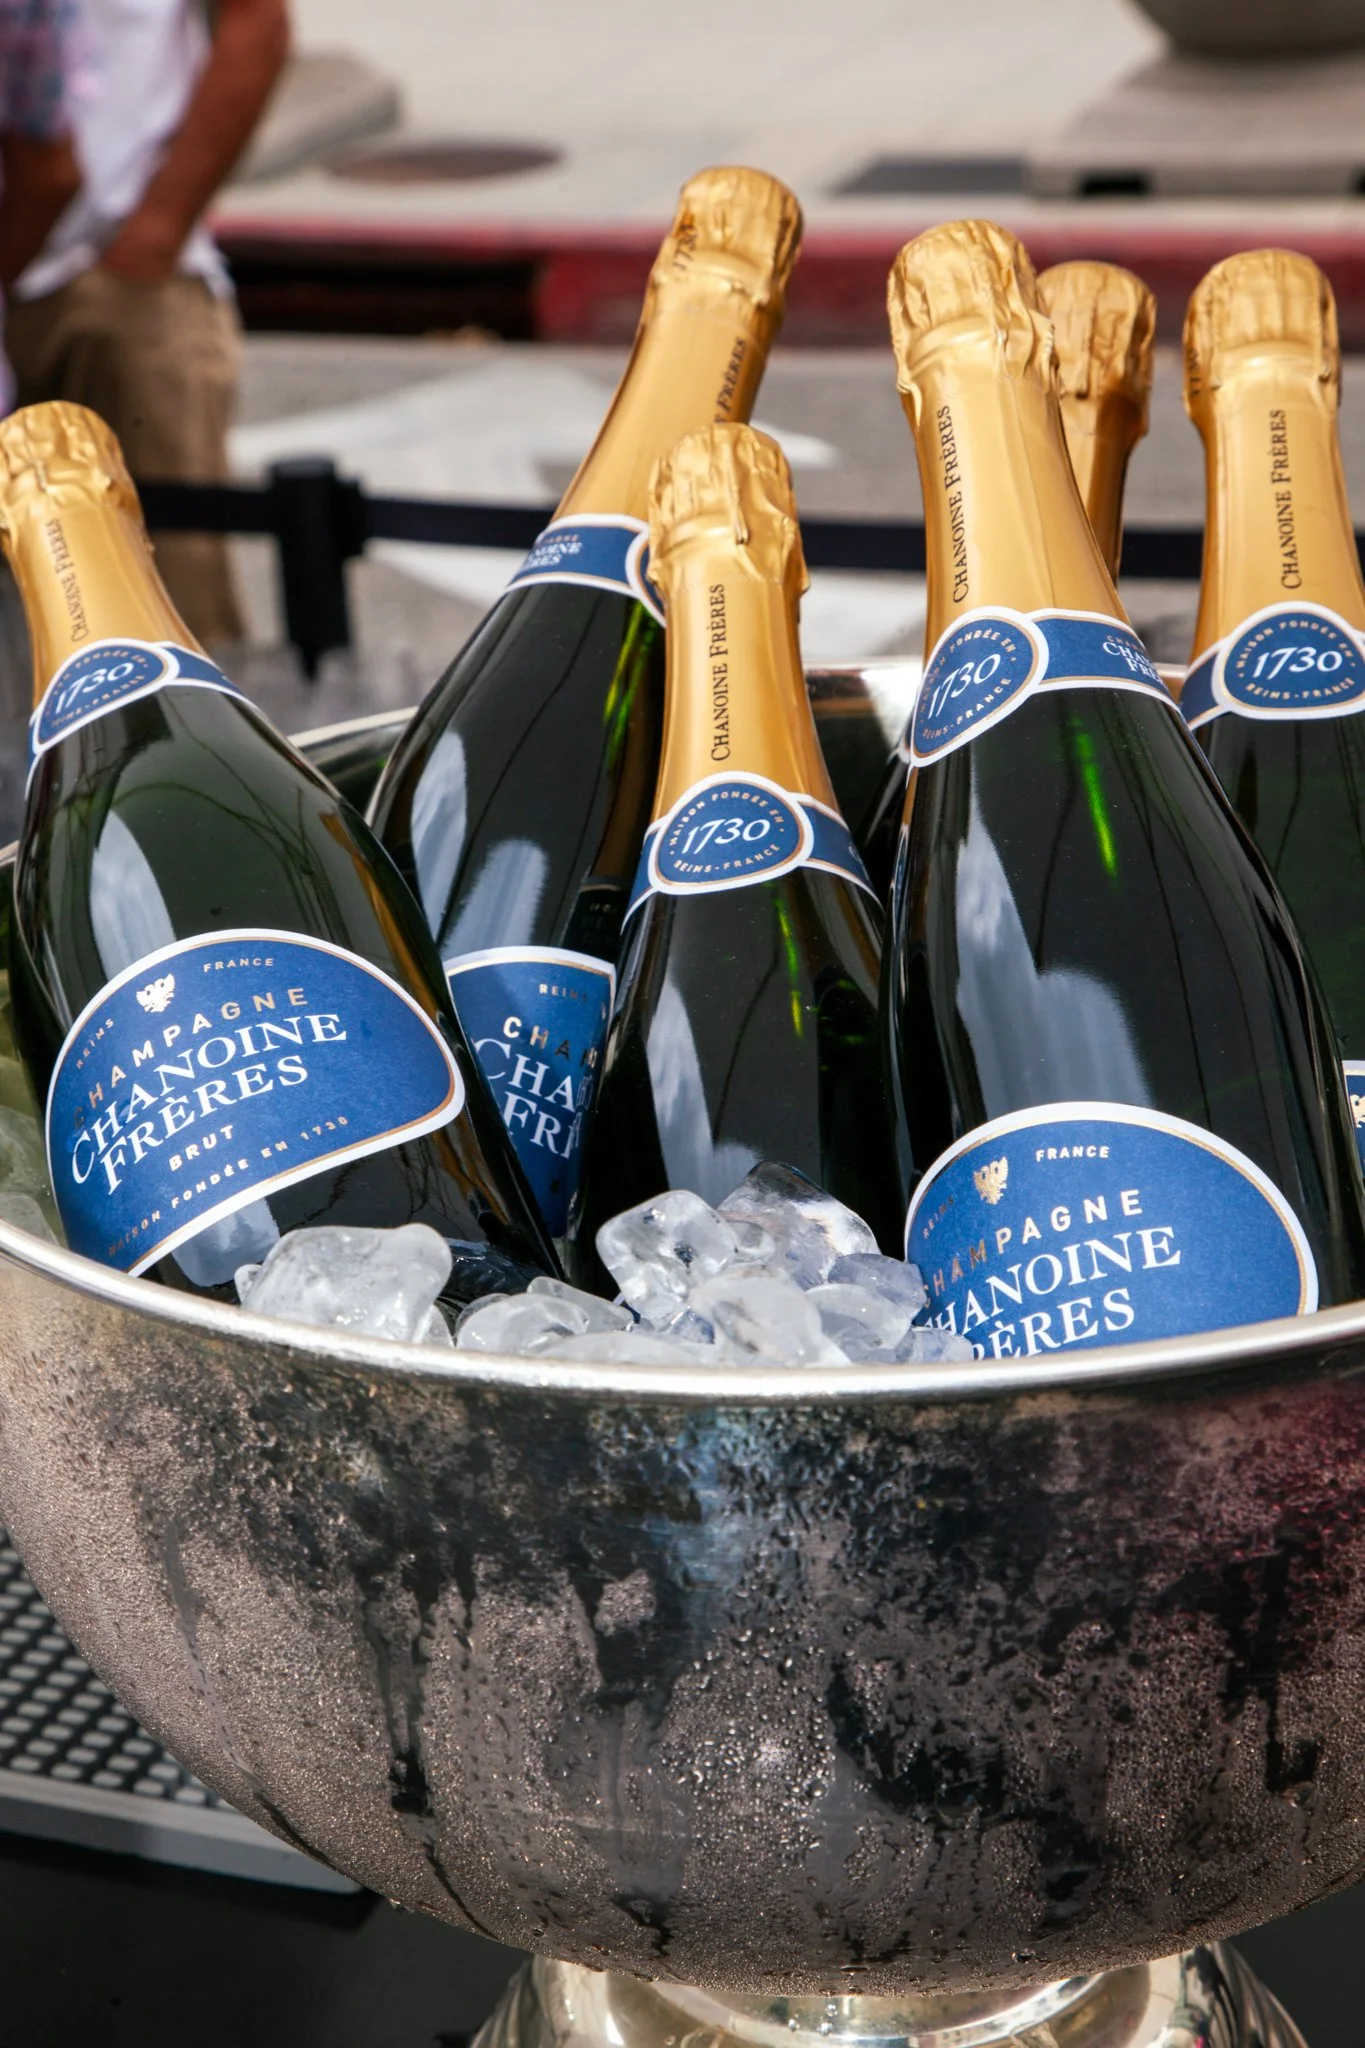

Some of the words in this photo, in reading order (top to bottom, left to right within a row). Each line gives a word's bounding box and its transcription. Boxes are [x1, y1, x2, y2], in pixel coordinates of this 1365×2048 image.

[937, 405, 961, 490] FRÈRES
[1268, 409, 1292, 484] FRÈRES
[949, 491, 970, 604] CHANOINE
[1276, 490, 1302, 590] CHANOINE
[61, 572, 89, 642] CHANOINE
[706, 584, 729, 657] FRÈRES
[55, 662, 134, 715] 1730
[928, 653, 1001, 719] 1730
[1252, 646, 1343, 680] 1730
[711, 663, 731, 761] CHANOINE
[681, 817, 771, 855] 1730
[203, 957, 274, 973] FRANCE
[74, 987, 309, 1129] CHAMPAGNE
[72, 1014, 347, 1184] CHANOINE
[100, 1055, 308, 1195] FRÈRES
[168, 1124, 234, 1171] BRUT
[171, 1158, 249, 1208] FONDÉE
[261, 1141, 288, 1158] EN
[300, 1116, 348, 1140] 1730
[1035, 1145, 1110, 1162] FRANCE
[923, 1226, 1181, 1335] HANOINE
